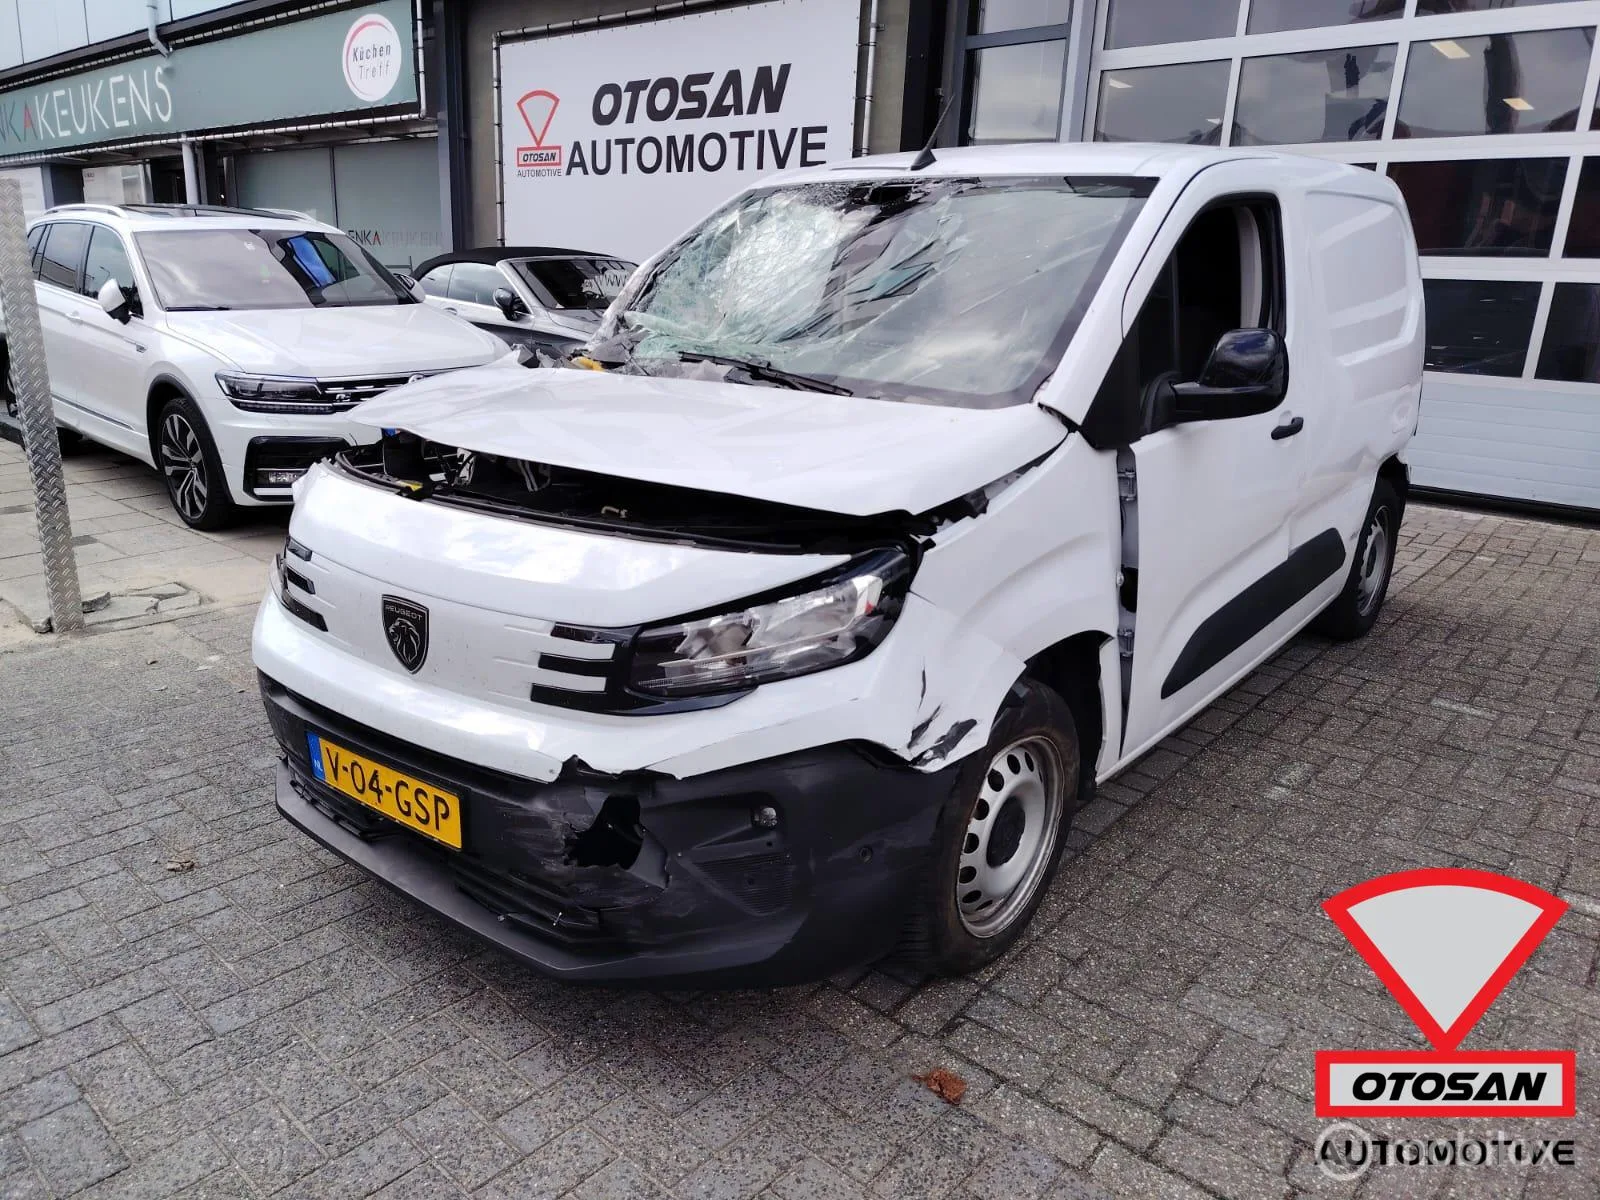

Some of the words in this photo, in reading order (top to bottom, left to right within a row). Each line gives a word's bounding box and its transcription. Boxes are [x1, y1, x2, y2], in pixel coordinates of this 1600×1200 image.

[353, 43, 391, 62] Küchen
[360, 60, 390, 79] Treff
[592, 63, 792, 125] OTOSAN
[522, 152, 557, 162] OTOSAN
[565, 125, 828, 176] AUTOMOTIVE
[517, 168, 562, 178] AUTOMOTIVE
[385, 604, 423, 621] PEUGEOT
[325, 746, 450, 831] V-04-GSP
